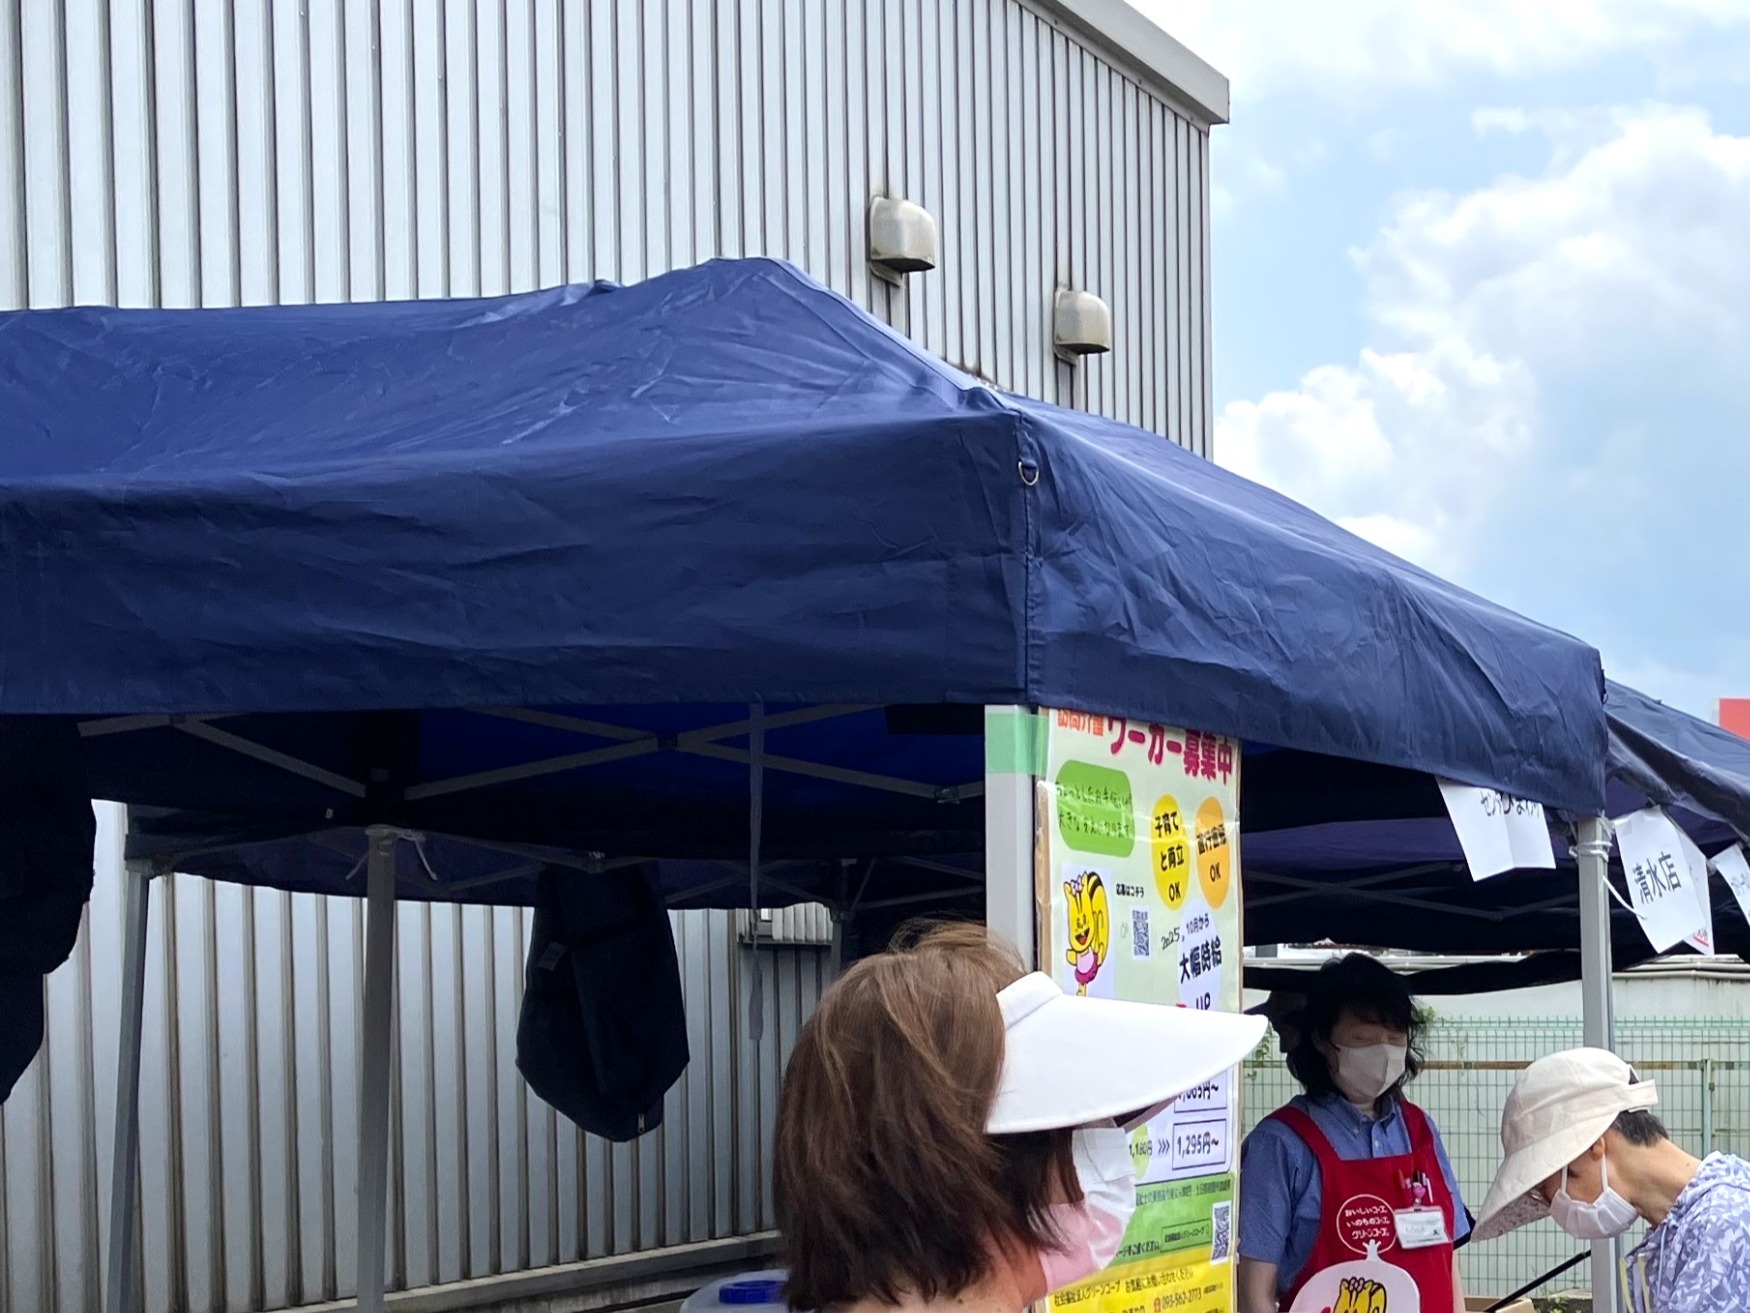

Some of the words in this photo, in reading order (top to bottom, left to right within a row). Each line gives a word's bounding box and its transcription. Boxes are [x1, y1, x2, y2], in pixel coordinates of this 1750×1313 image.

[1155, 811, 1179, 838] 子育て
[1209, 862, 1221, 882] OK
[1168, 881, 1181, 902] OK
